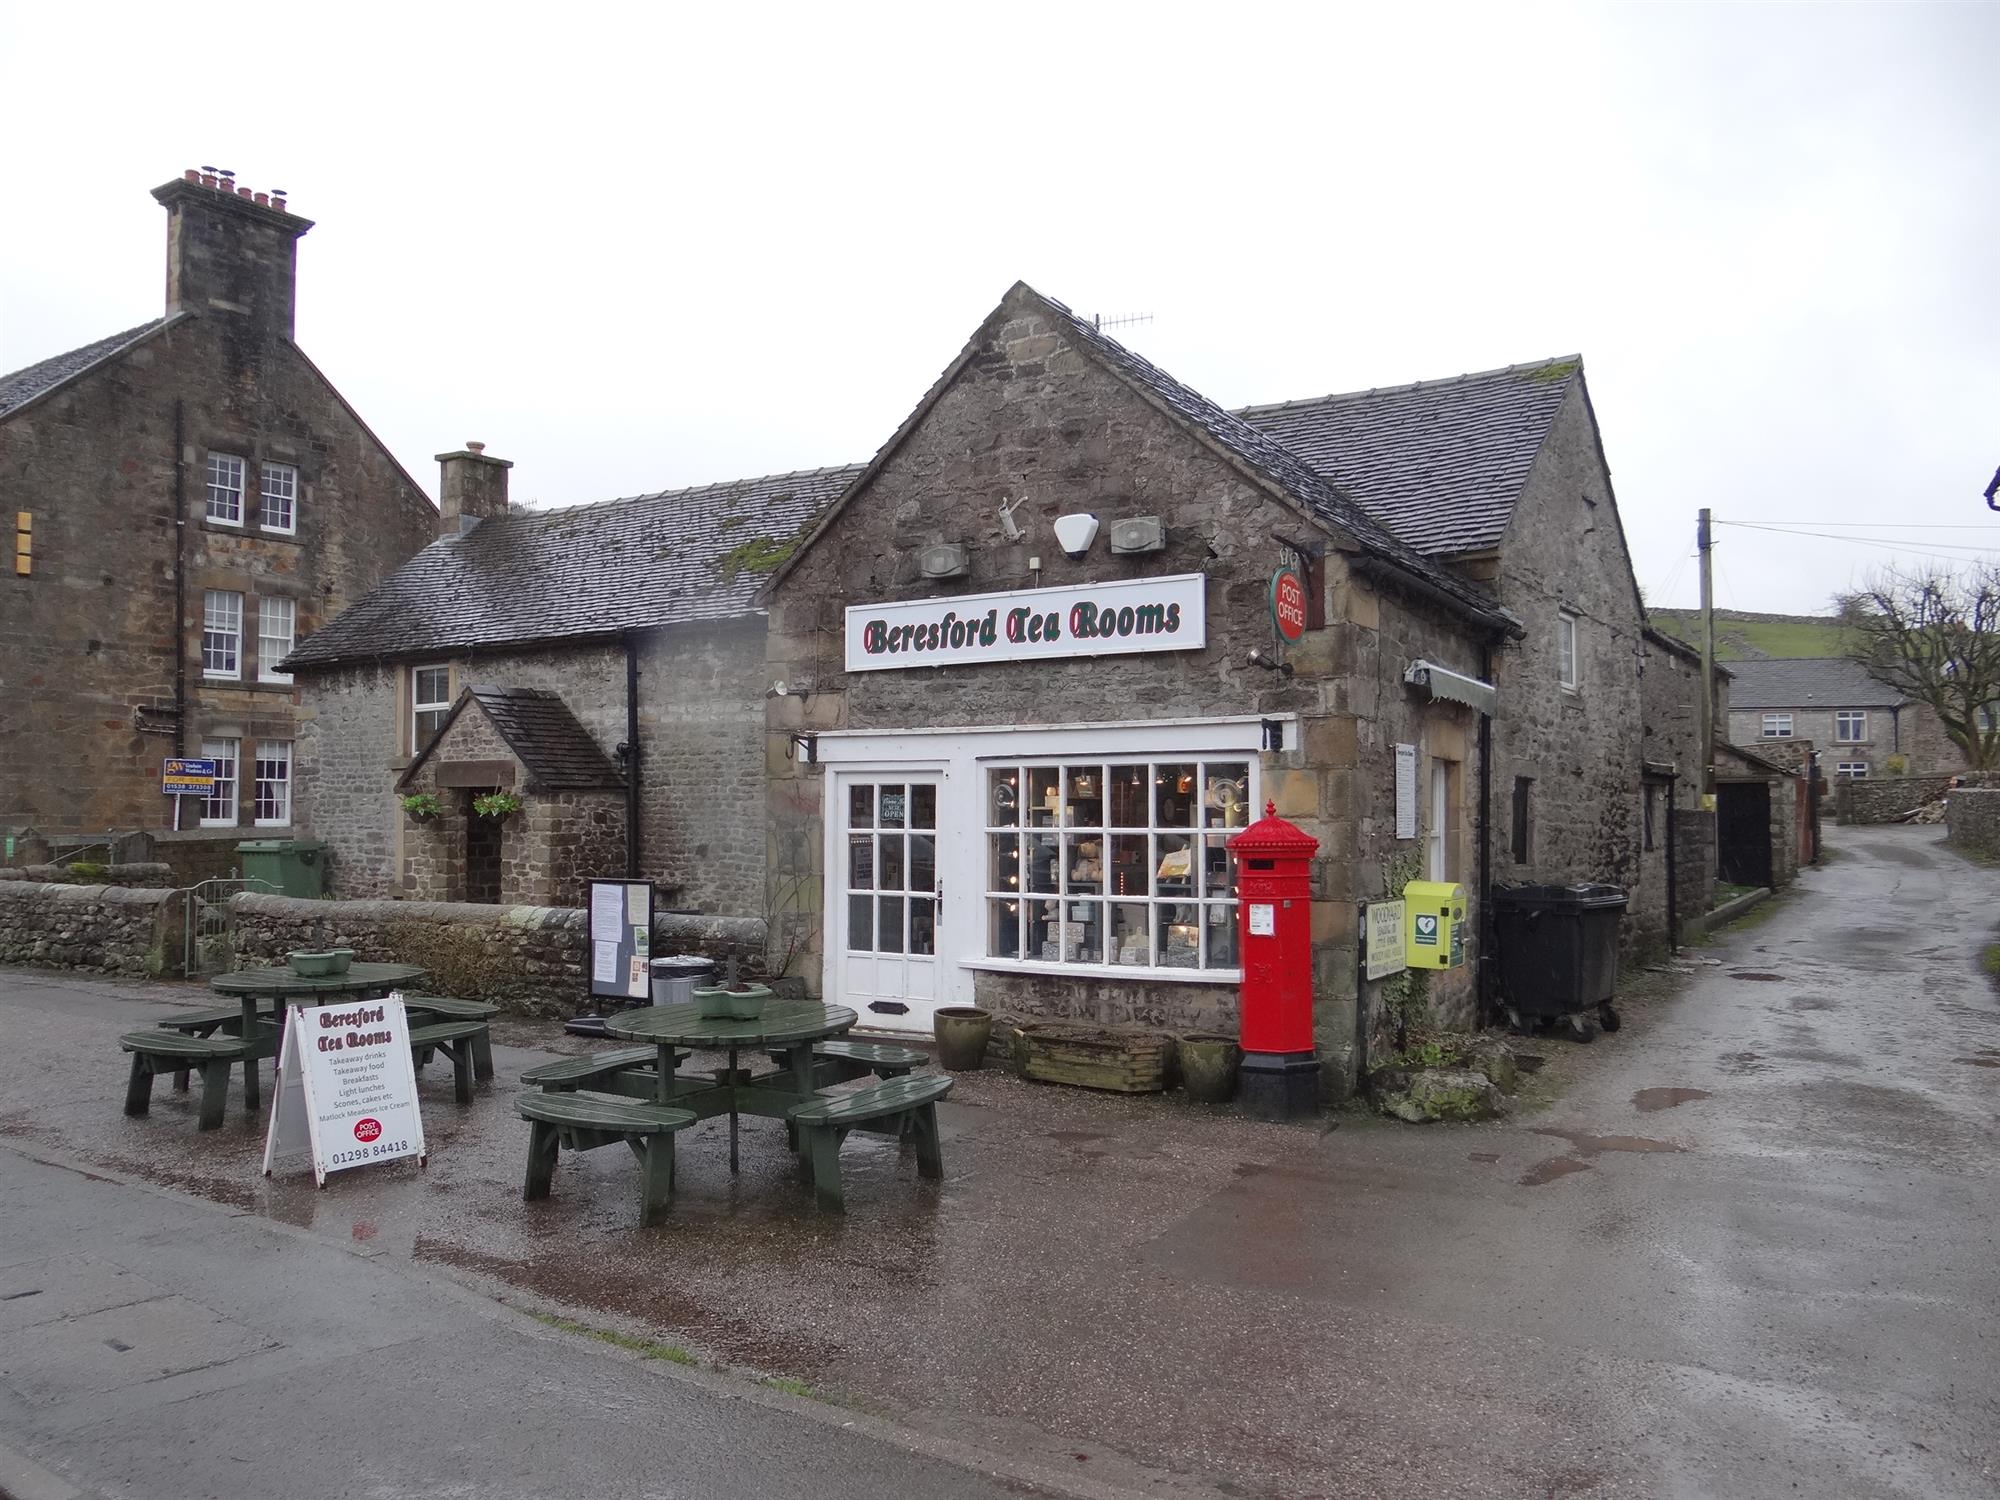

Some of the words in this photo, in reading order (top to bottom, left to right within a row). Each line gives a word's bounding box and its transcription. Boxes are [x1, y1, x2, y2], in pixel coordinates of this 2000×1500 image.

[1282, 584, 1300, 606] POST
[1278, 603, 1303, 626] OFFICE
[864, 609, 998, 655] Beresford
[1006, 607, 1061, 644] Tea
[1069, 601, 1181, 639] Rooms
[320, 1006, 384, 1028] Beresford
[318, 1036, 343, 1052] Tea
[346, 1030, 392, 1048] Rooms
[329, 1055, 363, 1066] Takeaway
[364, 1051, 387, 1061] drinks
[333, 1065, 367, 1077] Takeaway
[368, 1062, 385, 1072] food
[343, 1073, 379, 1086] Breakfasts
[339, 1086, 358, 1098] Light
[359, 1083, 385, 1094] lunches
[334, 1097, 361, 1109] Scones,
[362, 1095, 381, 1105] cakes
[382, 1093, 393, 1101] etc
[319, 1110, 346, 1123] Matlock
[347, 1106, 378, 1118] Meadows
[389, 1101, 410, 1111] Cream
[356, 1128, 380, 1139] OFFICE
[359, 1122, 377, 1131] POST
[332, 1148, 370, 1165] 01298
[373, 1140, 408, 1156] 84418
